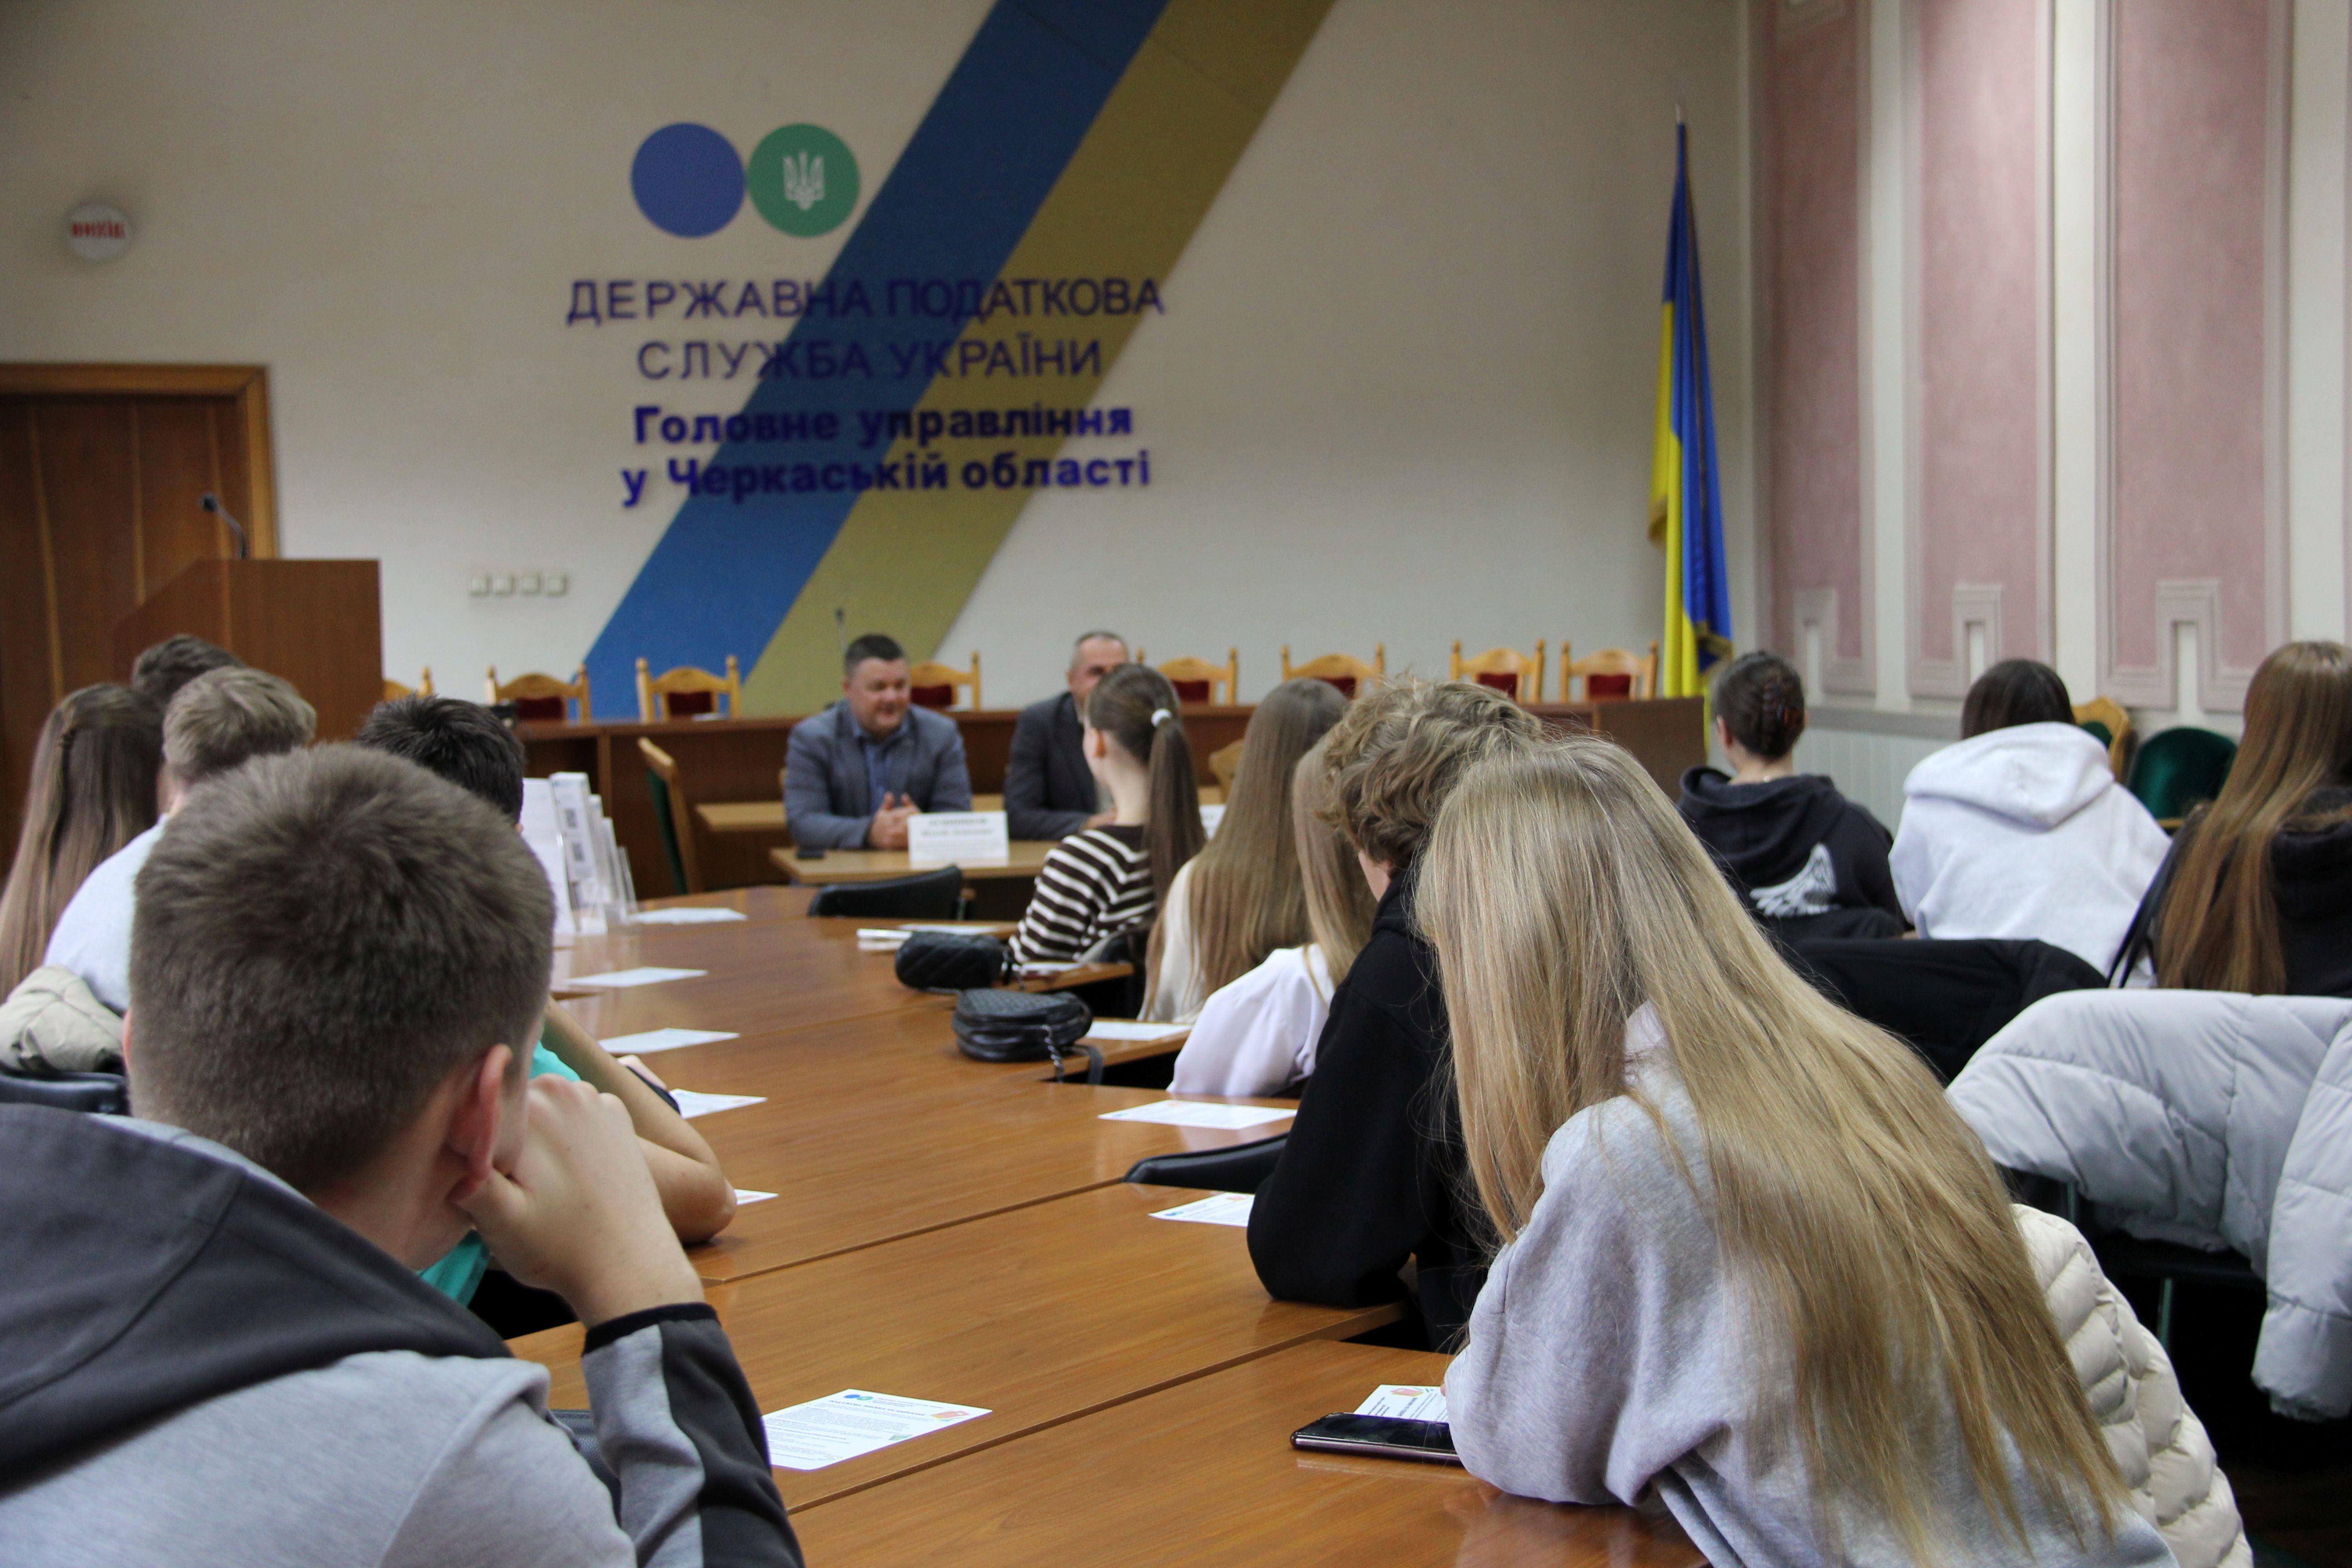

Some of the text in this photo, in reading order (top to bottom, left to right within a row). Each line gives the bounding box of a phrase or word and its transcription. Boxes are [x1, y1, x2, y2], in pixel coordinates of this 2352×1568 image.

[567, 277, 1165, 327] ДЕРЖАВНА ПОДАТКОВА
[638, 332, 1102, 380] СЛУЖБА УКРАЇНИ
[635, 403, 1132, 448] Головне управління
[622, 451, 1151, 507] у Черкаській області
